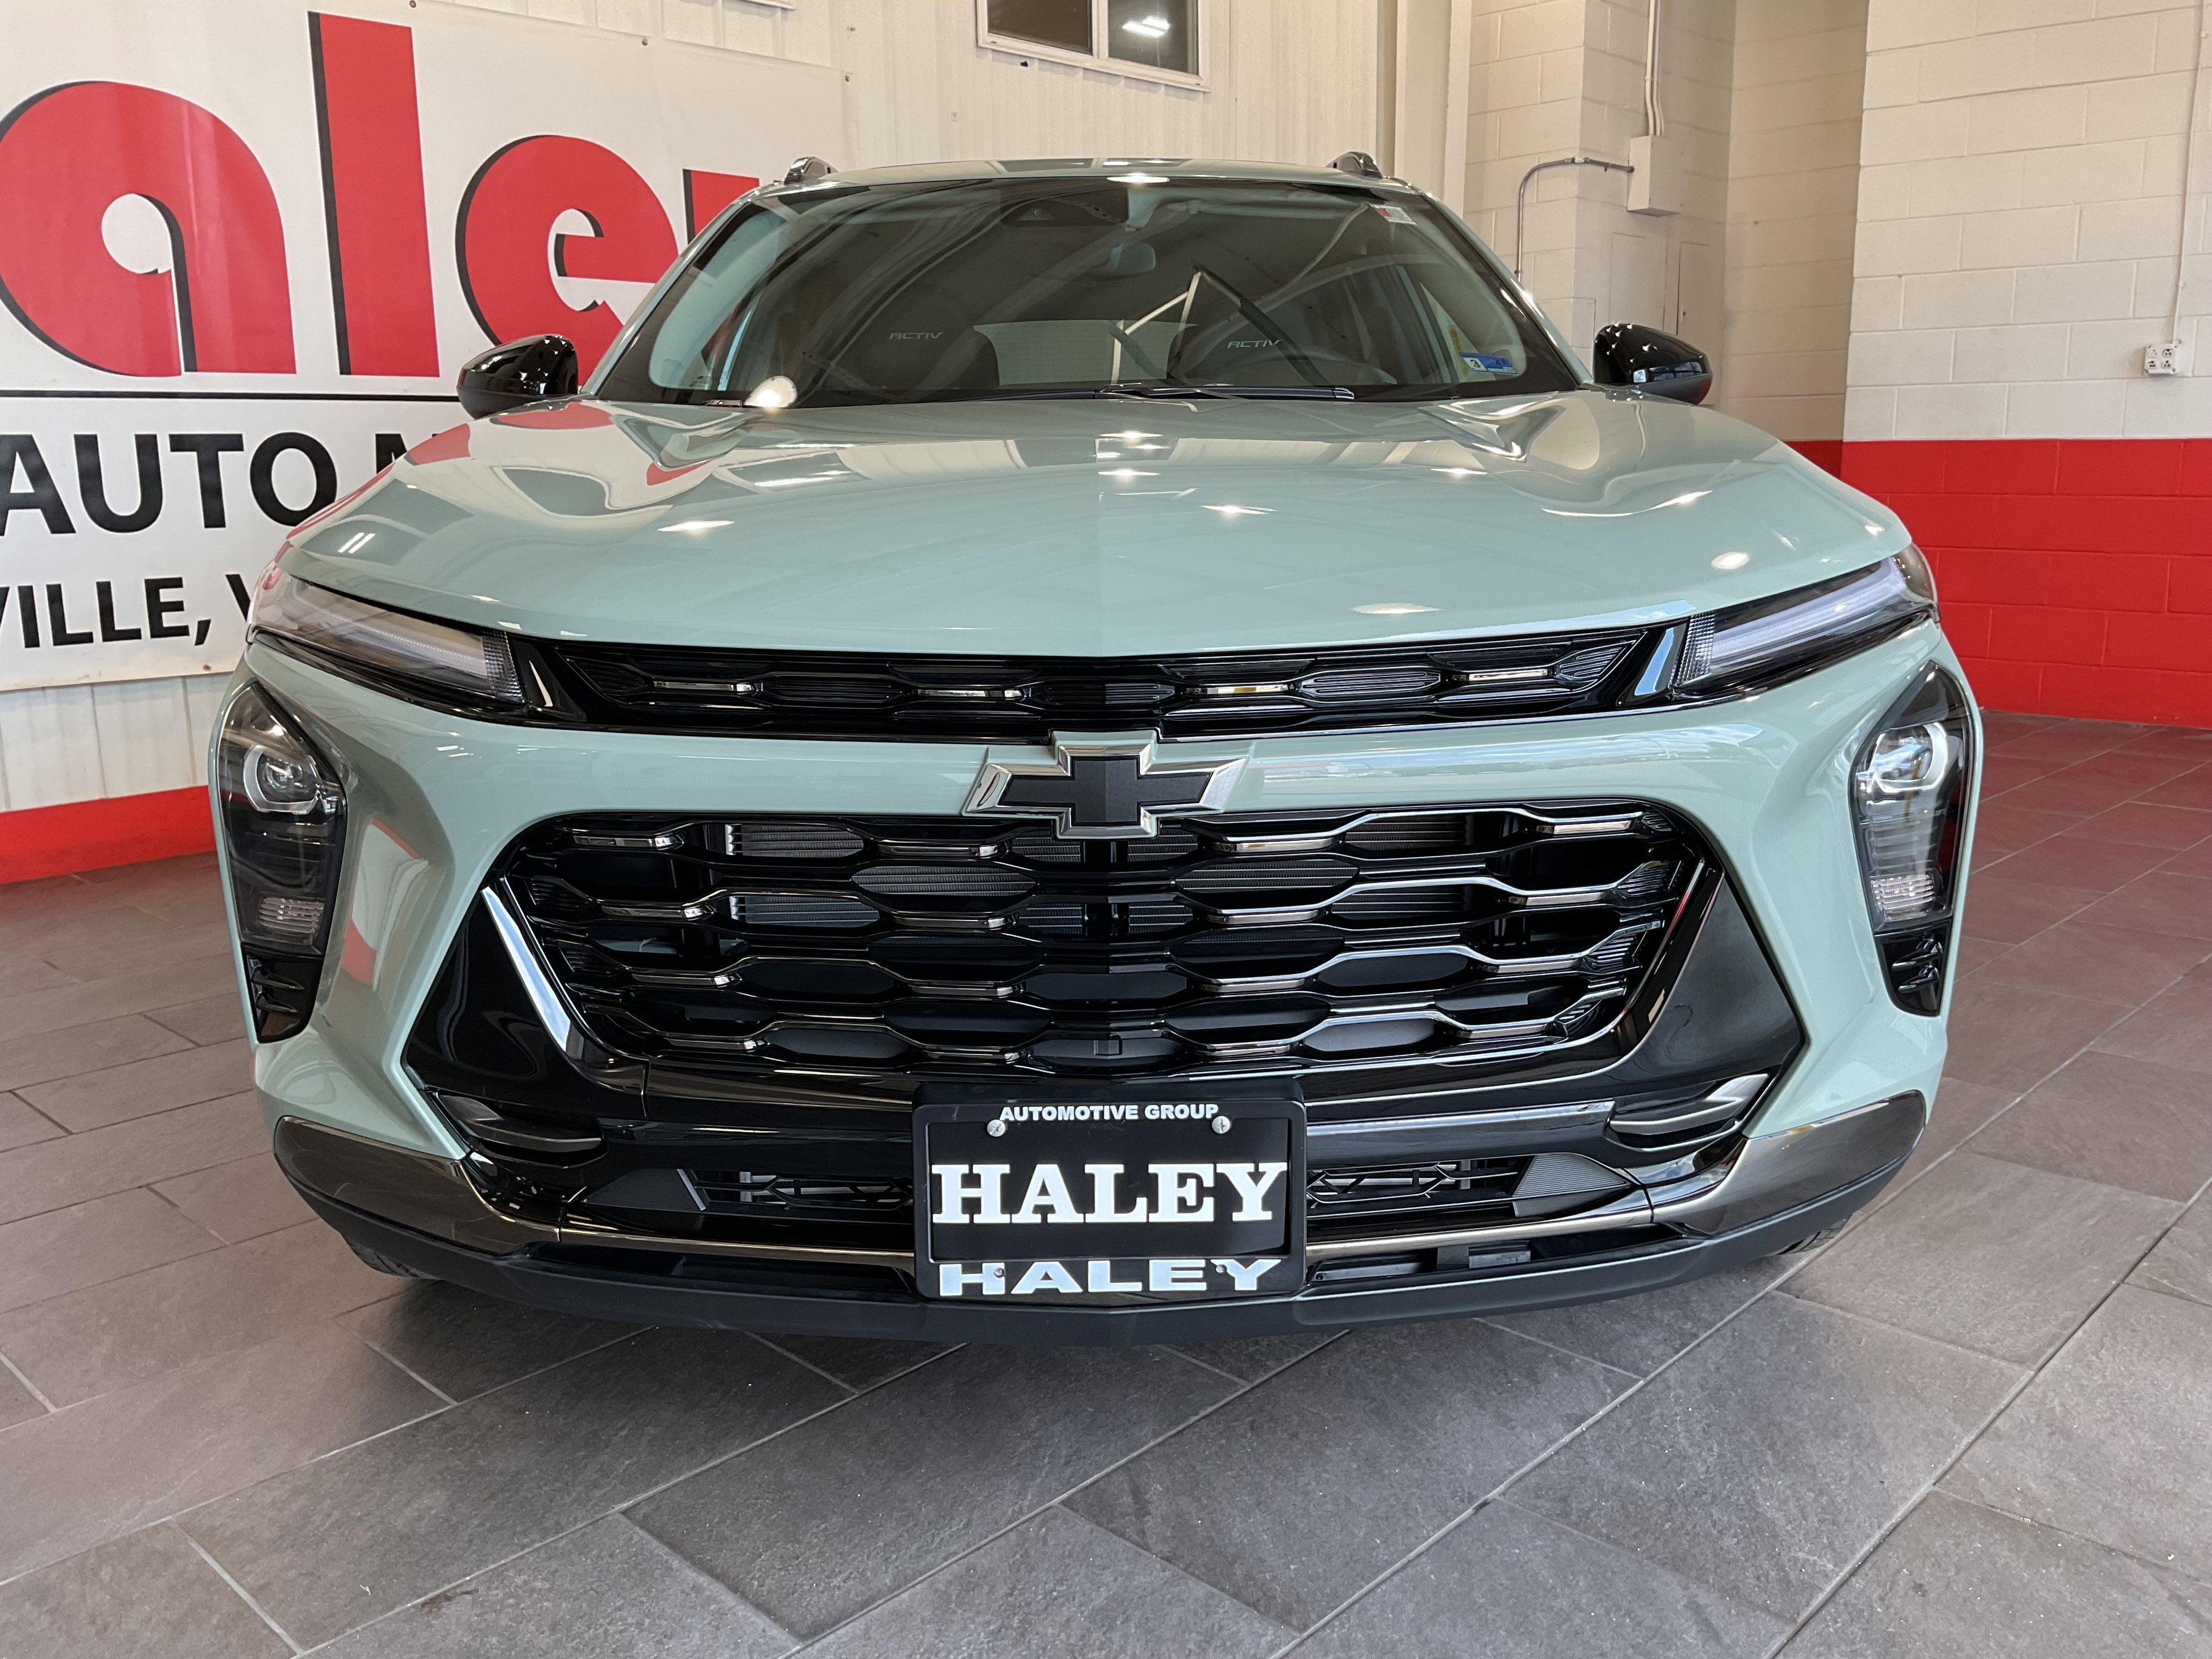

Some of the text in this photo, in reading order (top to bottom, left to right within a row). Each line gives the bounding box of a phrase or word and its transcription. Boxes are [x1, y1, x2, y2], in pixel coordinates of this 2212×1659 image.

[0, 12, 760, 392] ale
[1227, 340, 1282, 348] ACTIV
[1470, 359, 1481, 368] 3
[0, 432, 337, 535] AUTO
[1000, 1104, 1218, 1121] AUTOMOTIVE GROUP
[931, 1161, 1287, 1224] HALEY
[939, 1259, 1282, 1296] HALEY
